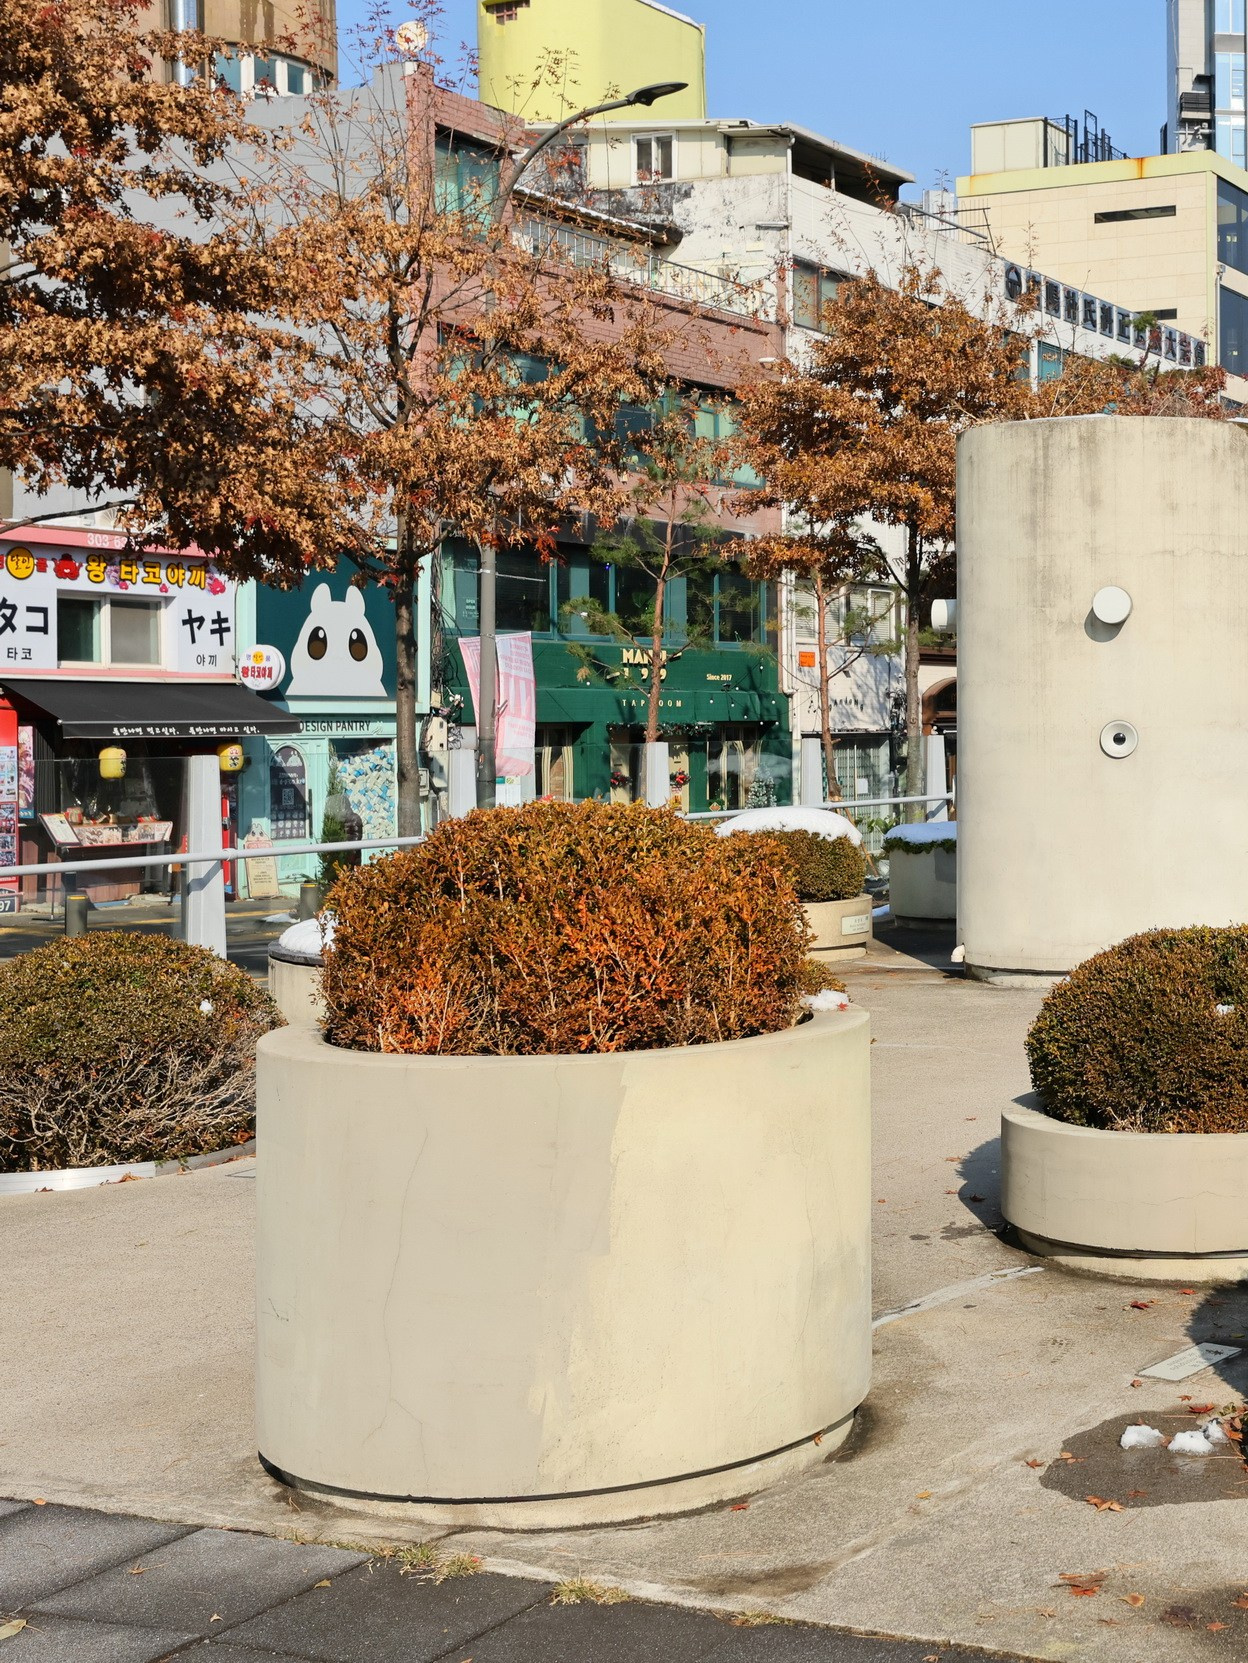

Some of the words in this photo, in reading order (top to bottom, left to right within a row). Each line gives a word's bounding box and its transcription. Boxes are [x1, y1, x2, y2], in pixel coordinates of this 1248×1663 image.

[86, 532, 109, 547] 303
[86, 554, 107, 583] 왕
[119, 558, 208, 590] 타코야끼
[0, 597, 49, 636] タコ
[182, 608, 231, 647] ヤキ
[7, 647, 32, 661] 타코
[196, 653, 217, 667] 야끼
[622, 699, 682, 708] TAPOOM
[335, 720, 371, 732] PANTRY
